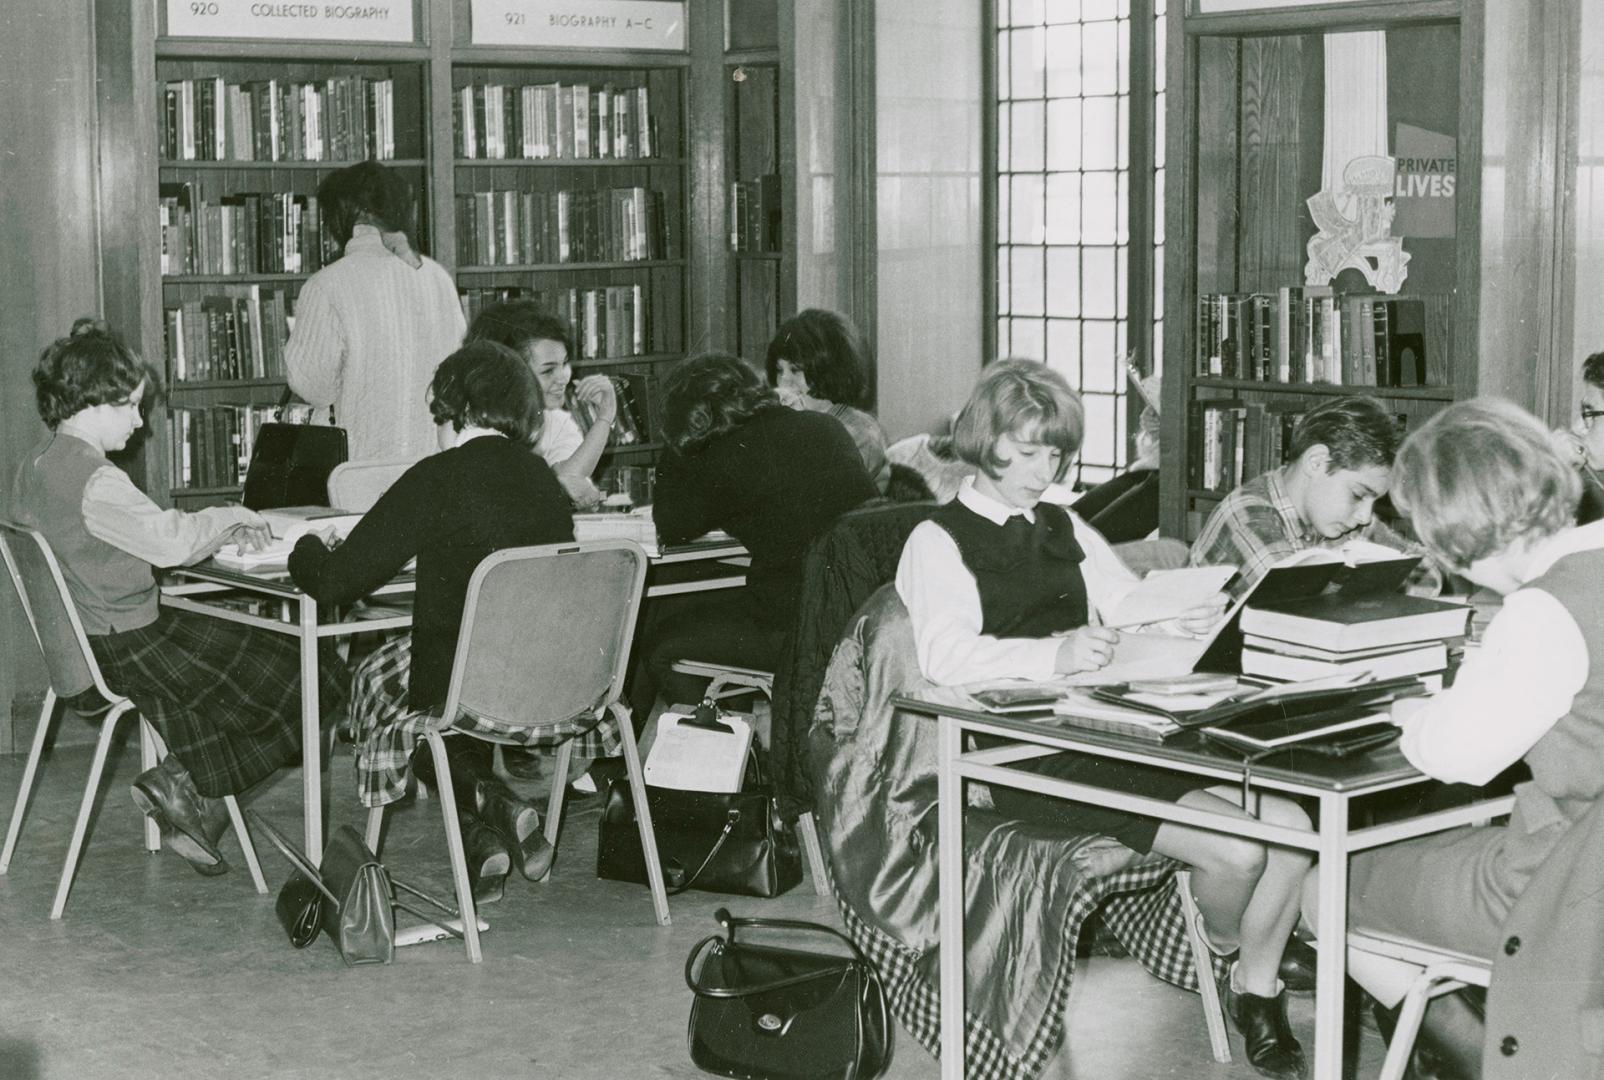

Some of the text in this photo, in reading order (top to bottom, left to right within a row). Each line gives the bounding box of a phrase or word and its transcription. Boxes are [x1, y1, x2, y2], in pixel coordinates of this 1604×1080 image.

[190, 1, 390, 19] 920 COLLECTED BIOGRAPHY
[504, 12, 526, 25] 921
[549, 14, 617, 28] BIOGRAPHY
[1397, 158, 1455, 173] PRIVATE
[1396, 174, 1456, 198] LIVES
